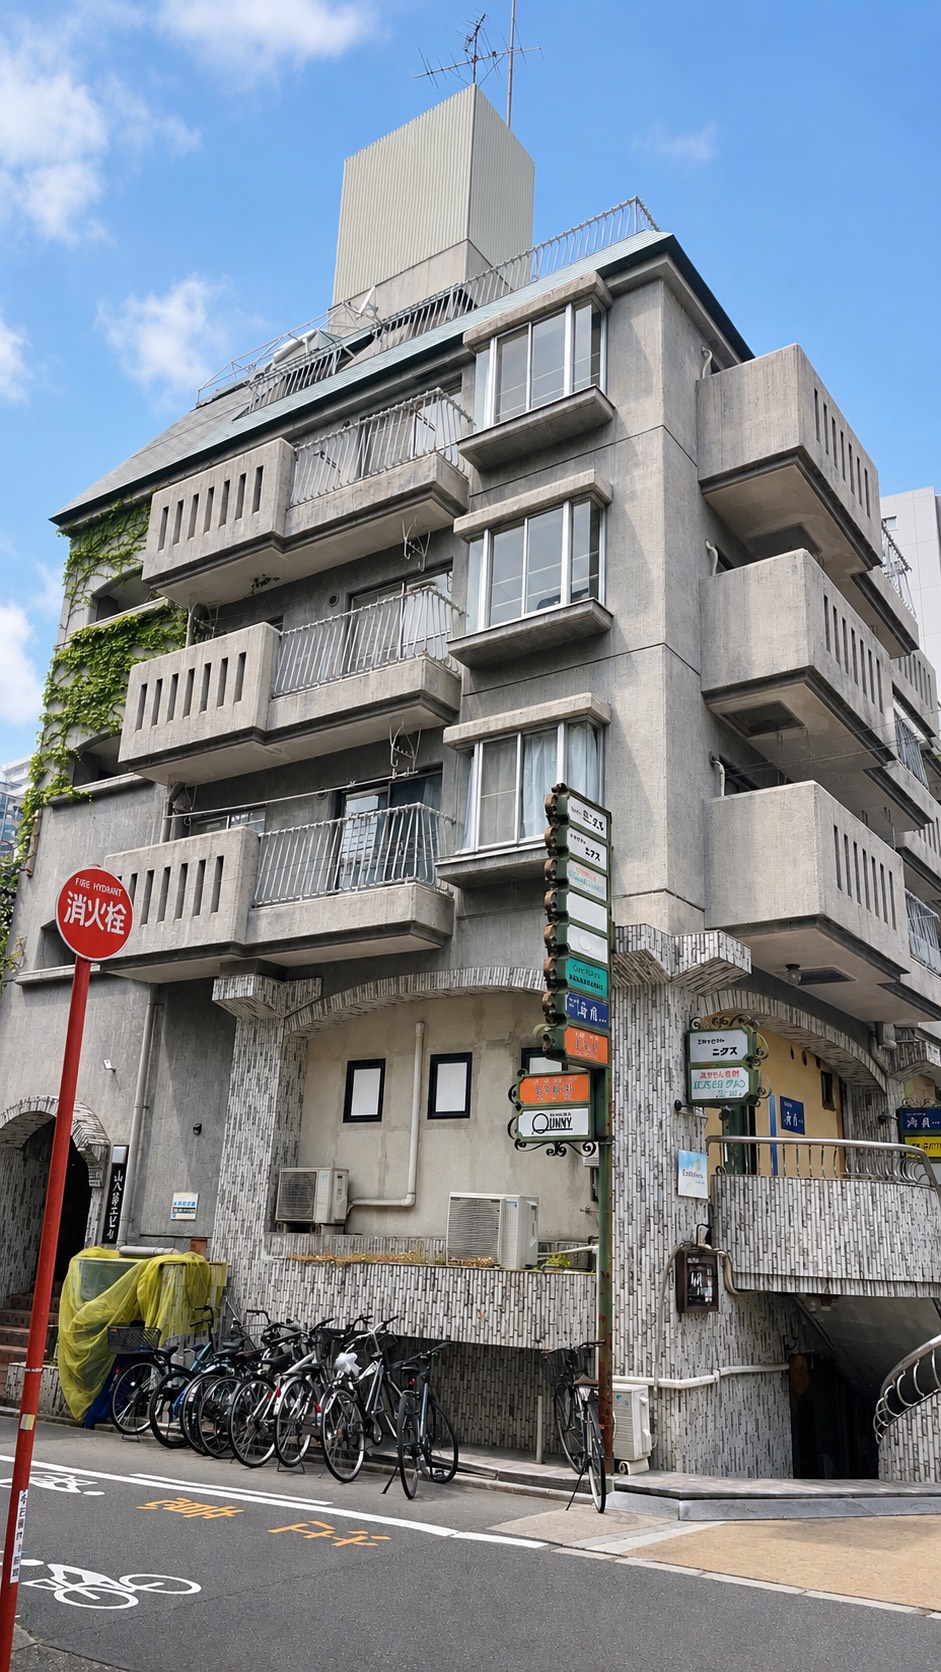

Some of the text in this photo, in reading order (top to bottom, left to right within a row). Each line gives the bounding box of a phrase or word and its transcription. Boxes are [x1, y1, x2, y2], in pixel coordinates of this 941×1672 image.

[75, 877, 123, 897] FIRE HYDRANT
[63, 890, 127, 935] 消火栓
[712, 1046, 738, 1056] ニクス
